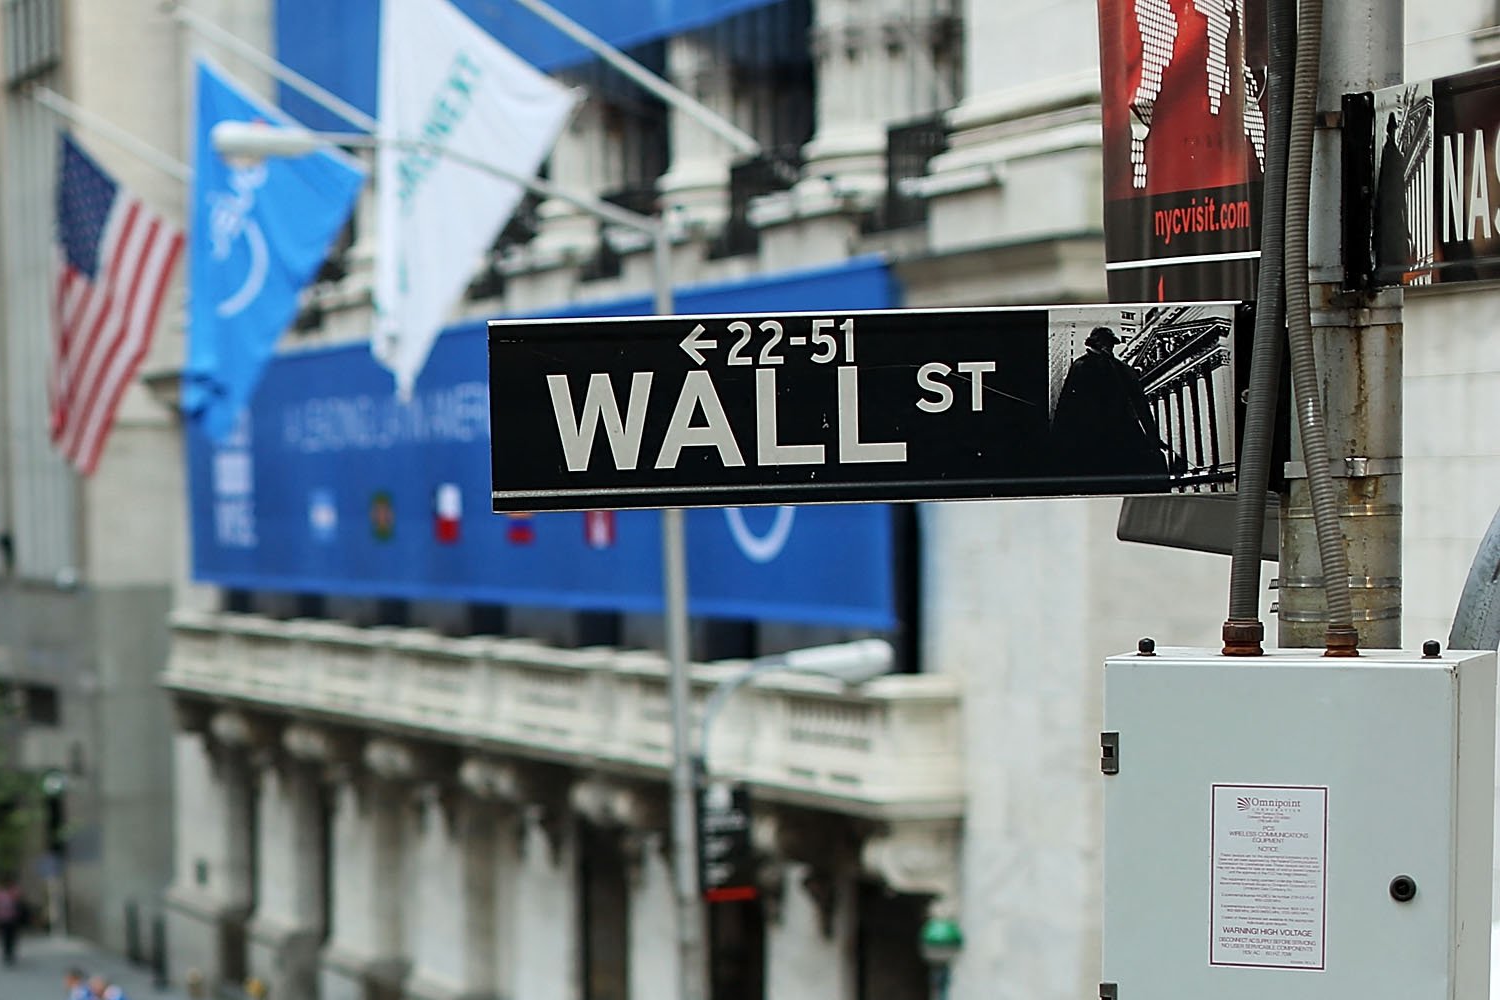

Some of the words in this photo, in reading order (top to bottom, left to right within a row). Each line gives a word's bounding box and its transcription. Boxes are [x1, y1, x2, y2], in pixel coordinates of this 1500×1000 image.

[1443, 124, 1500, 243] NA
[1155, 197, 1250, 245] nycvisit.com
[727, 318, 856, 366] 22-51
[546, 366, 908, 473] WALL
[916, 361, 997, 413] ST
[1251, 797, 1301, 810] Omnipoint
[1222, 927, 1259, 935] WARNING!
[1260, 928, 1278, 936] HIGH
[1280, 929, 1312, 937] VOLTAGE
